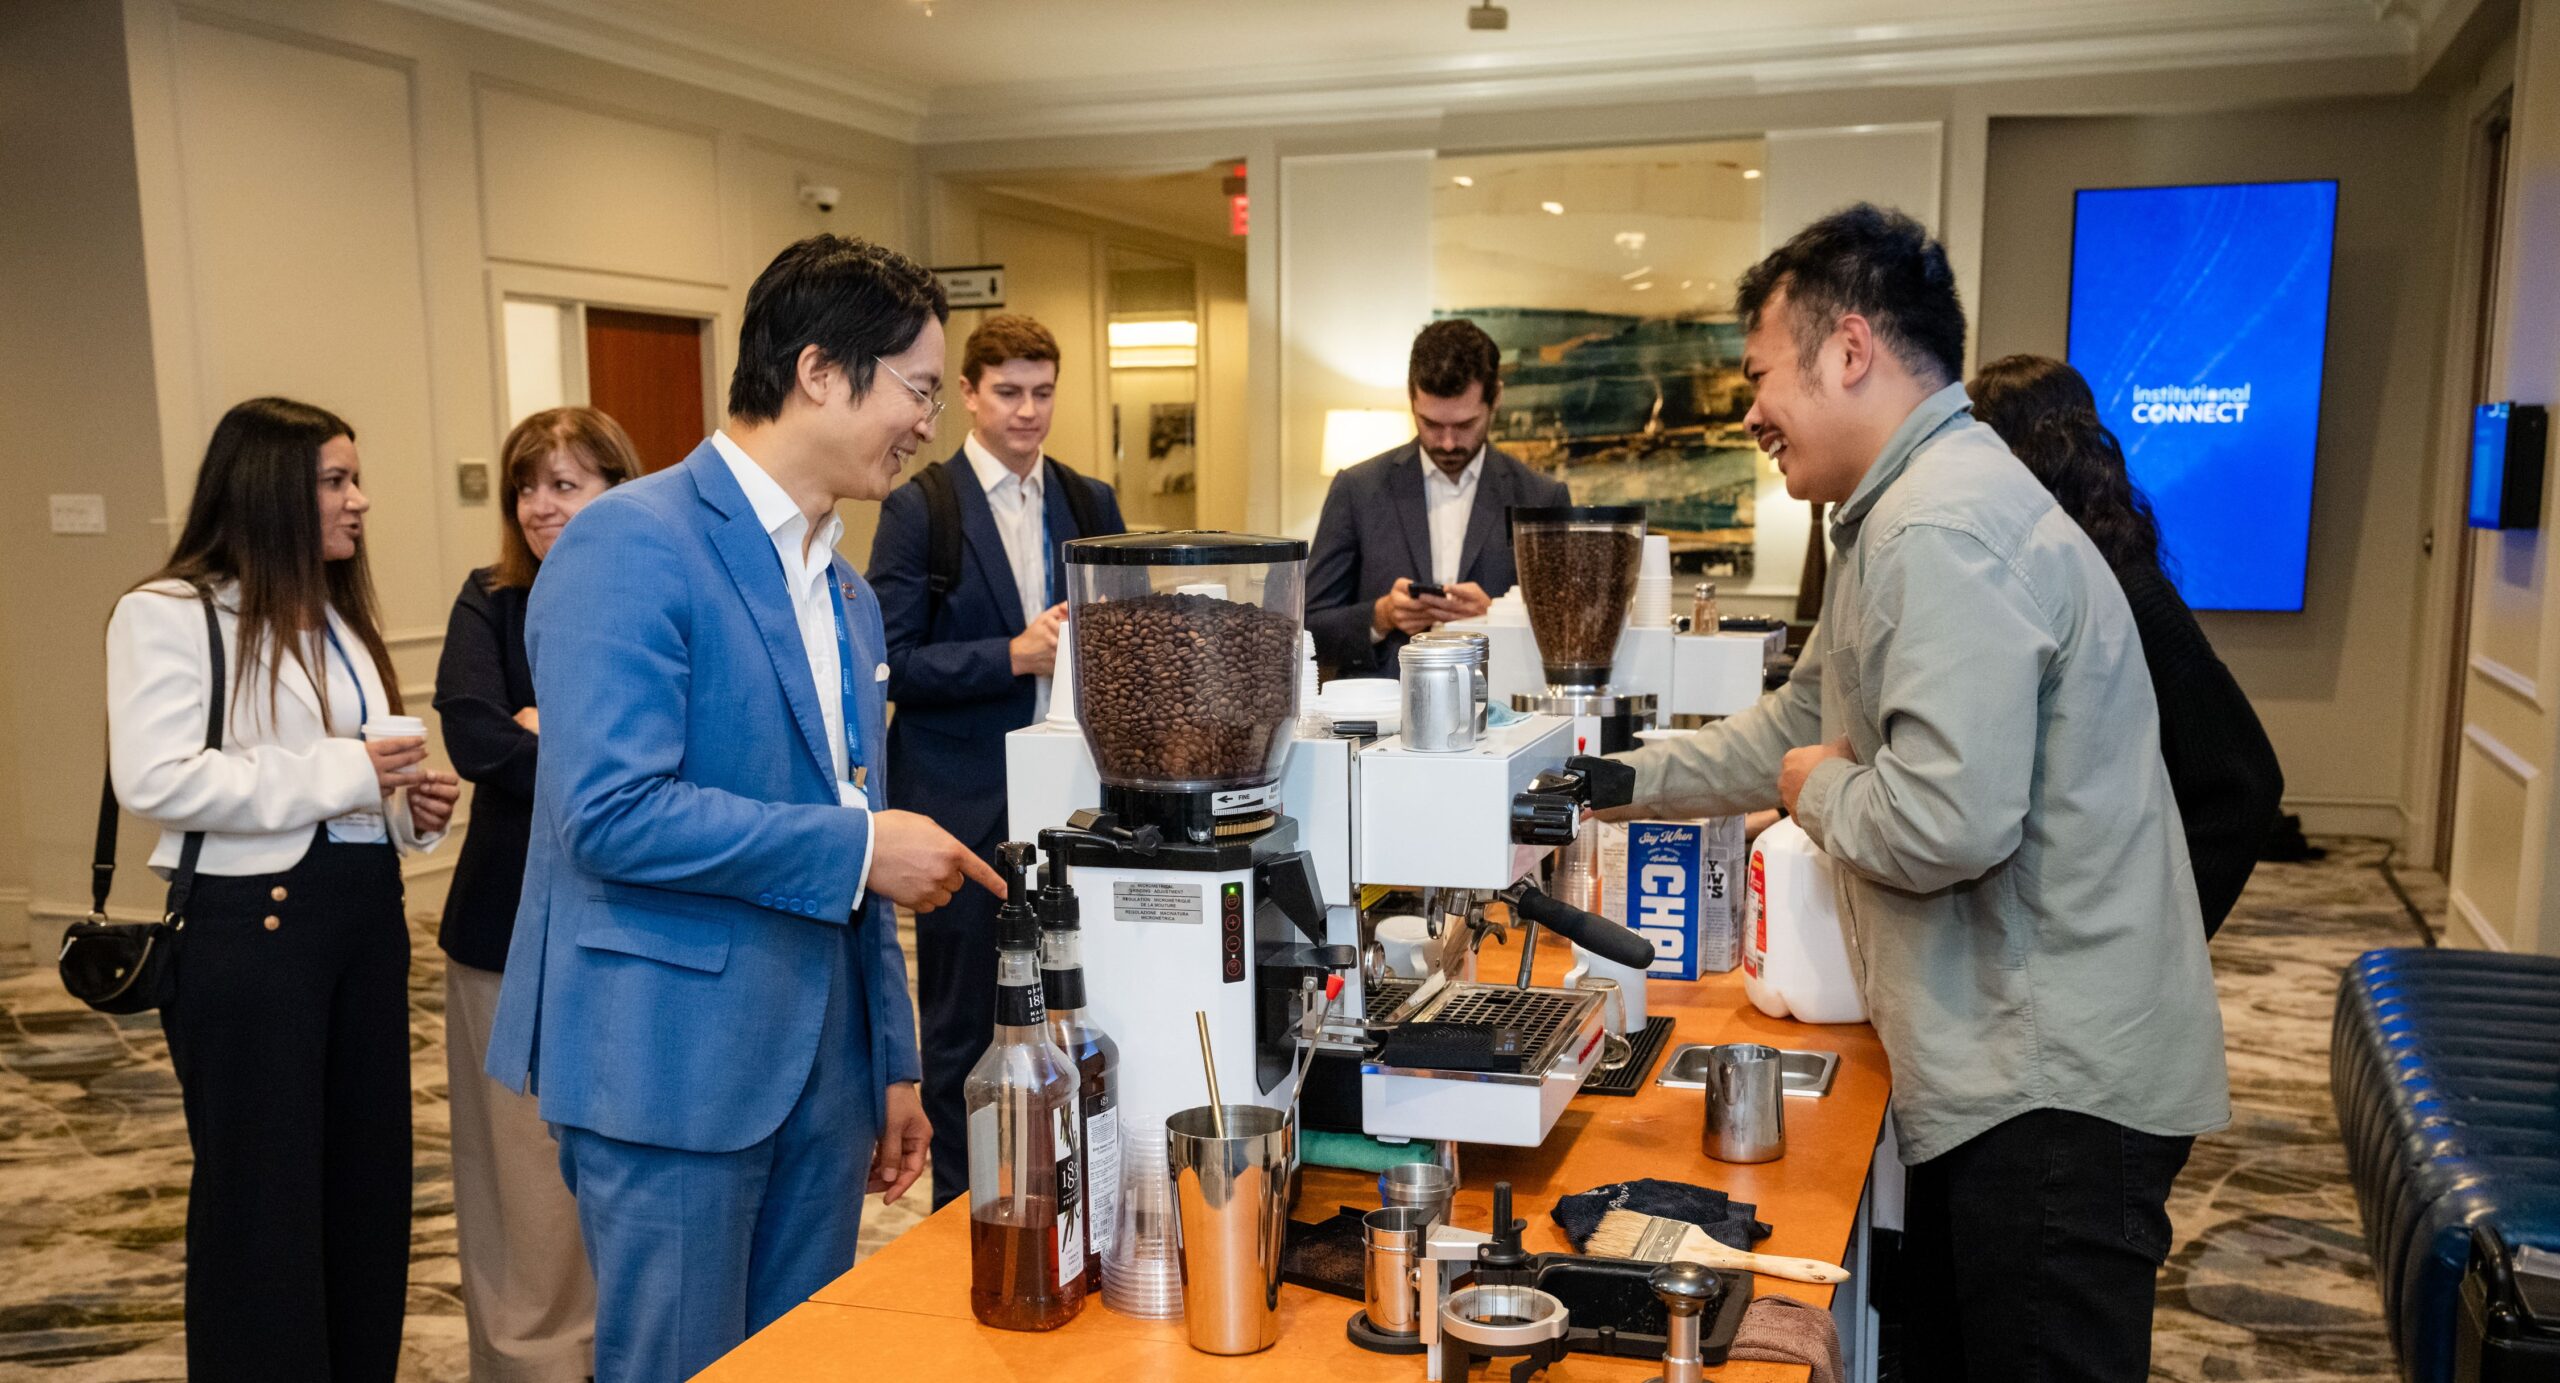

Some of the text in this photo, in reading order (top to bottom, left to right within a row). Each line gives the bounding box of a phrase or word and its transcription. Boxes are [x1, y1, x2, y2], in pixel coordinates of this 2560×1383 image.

[2132, 382, 2252, 403] institutional
[2131, 402, 2250, 424] CONNECT
[1238, 793, 1251, 801] FINE
[1638, 827, 1694, 846] Say When
[1639, 863, 1686, 974] CHAI
[1028, 993, 1045, 1008] 188
